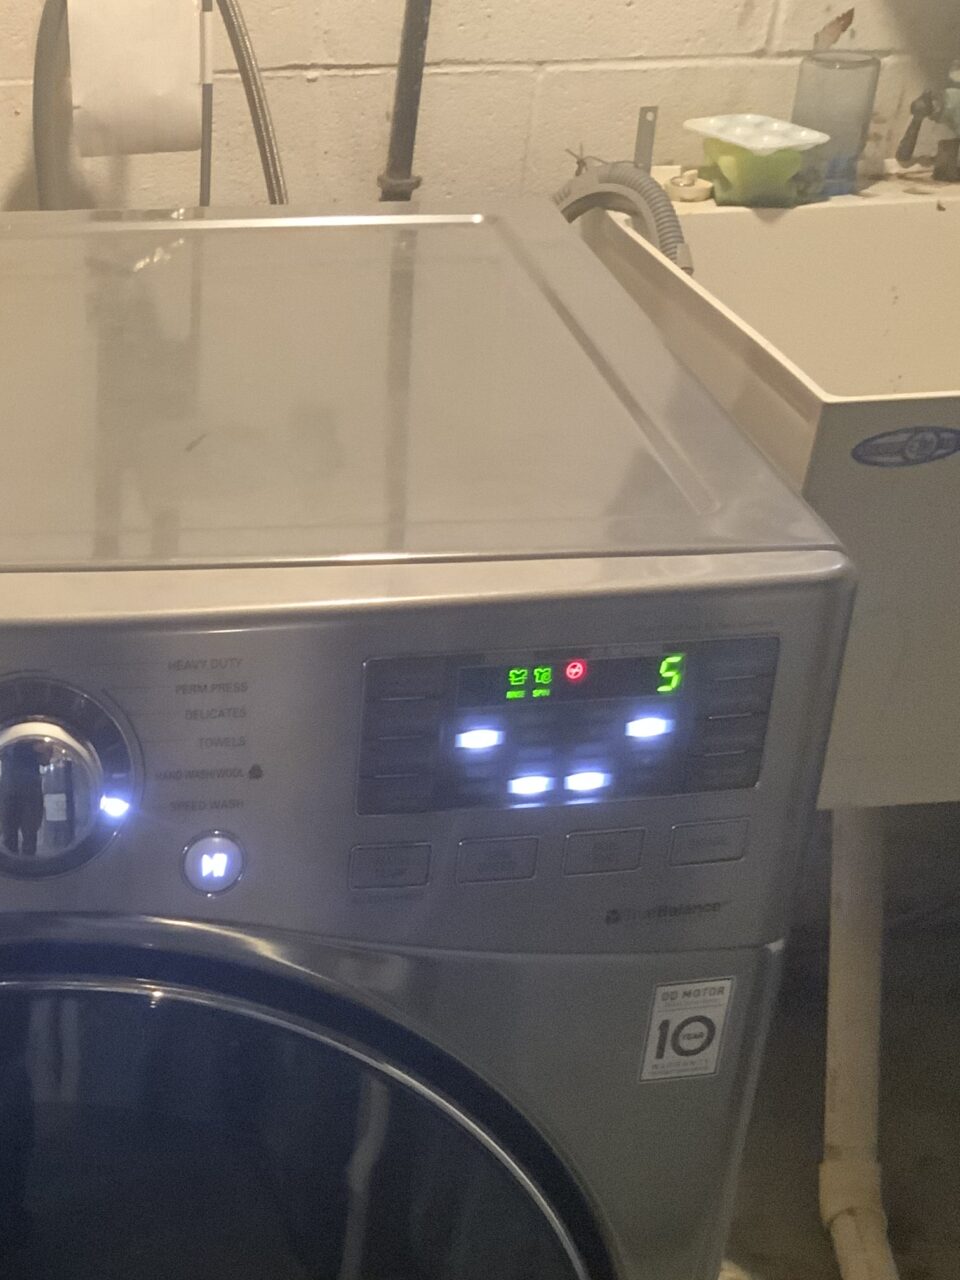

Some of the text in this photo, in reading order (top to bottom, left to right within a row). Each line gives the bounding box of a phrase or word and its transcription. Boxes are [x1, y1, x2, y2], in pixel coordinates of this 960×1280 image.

[167, 657, 243, 671] HEAVY DUTY
[210, 681, 248, 694] PRESS
[184, 706, 247, 721] DELICATES
[198, 736, 246, 750] TOWELS
[209, 799, 244, 810] WASH
[682, 986, 725, 999] MOTOR
[655, 1014, 716, 1059] 10
